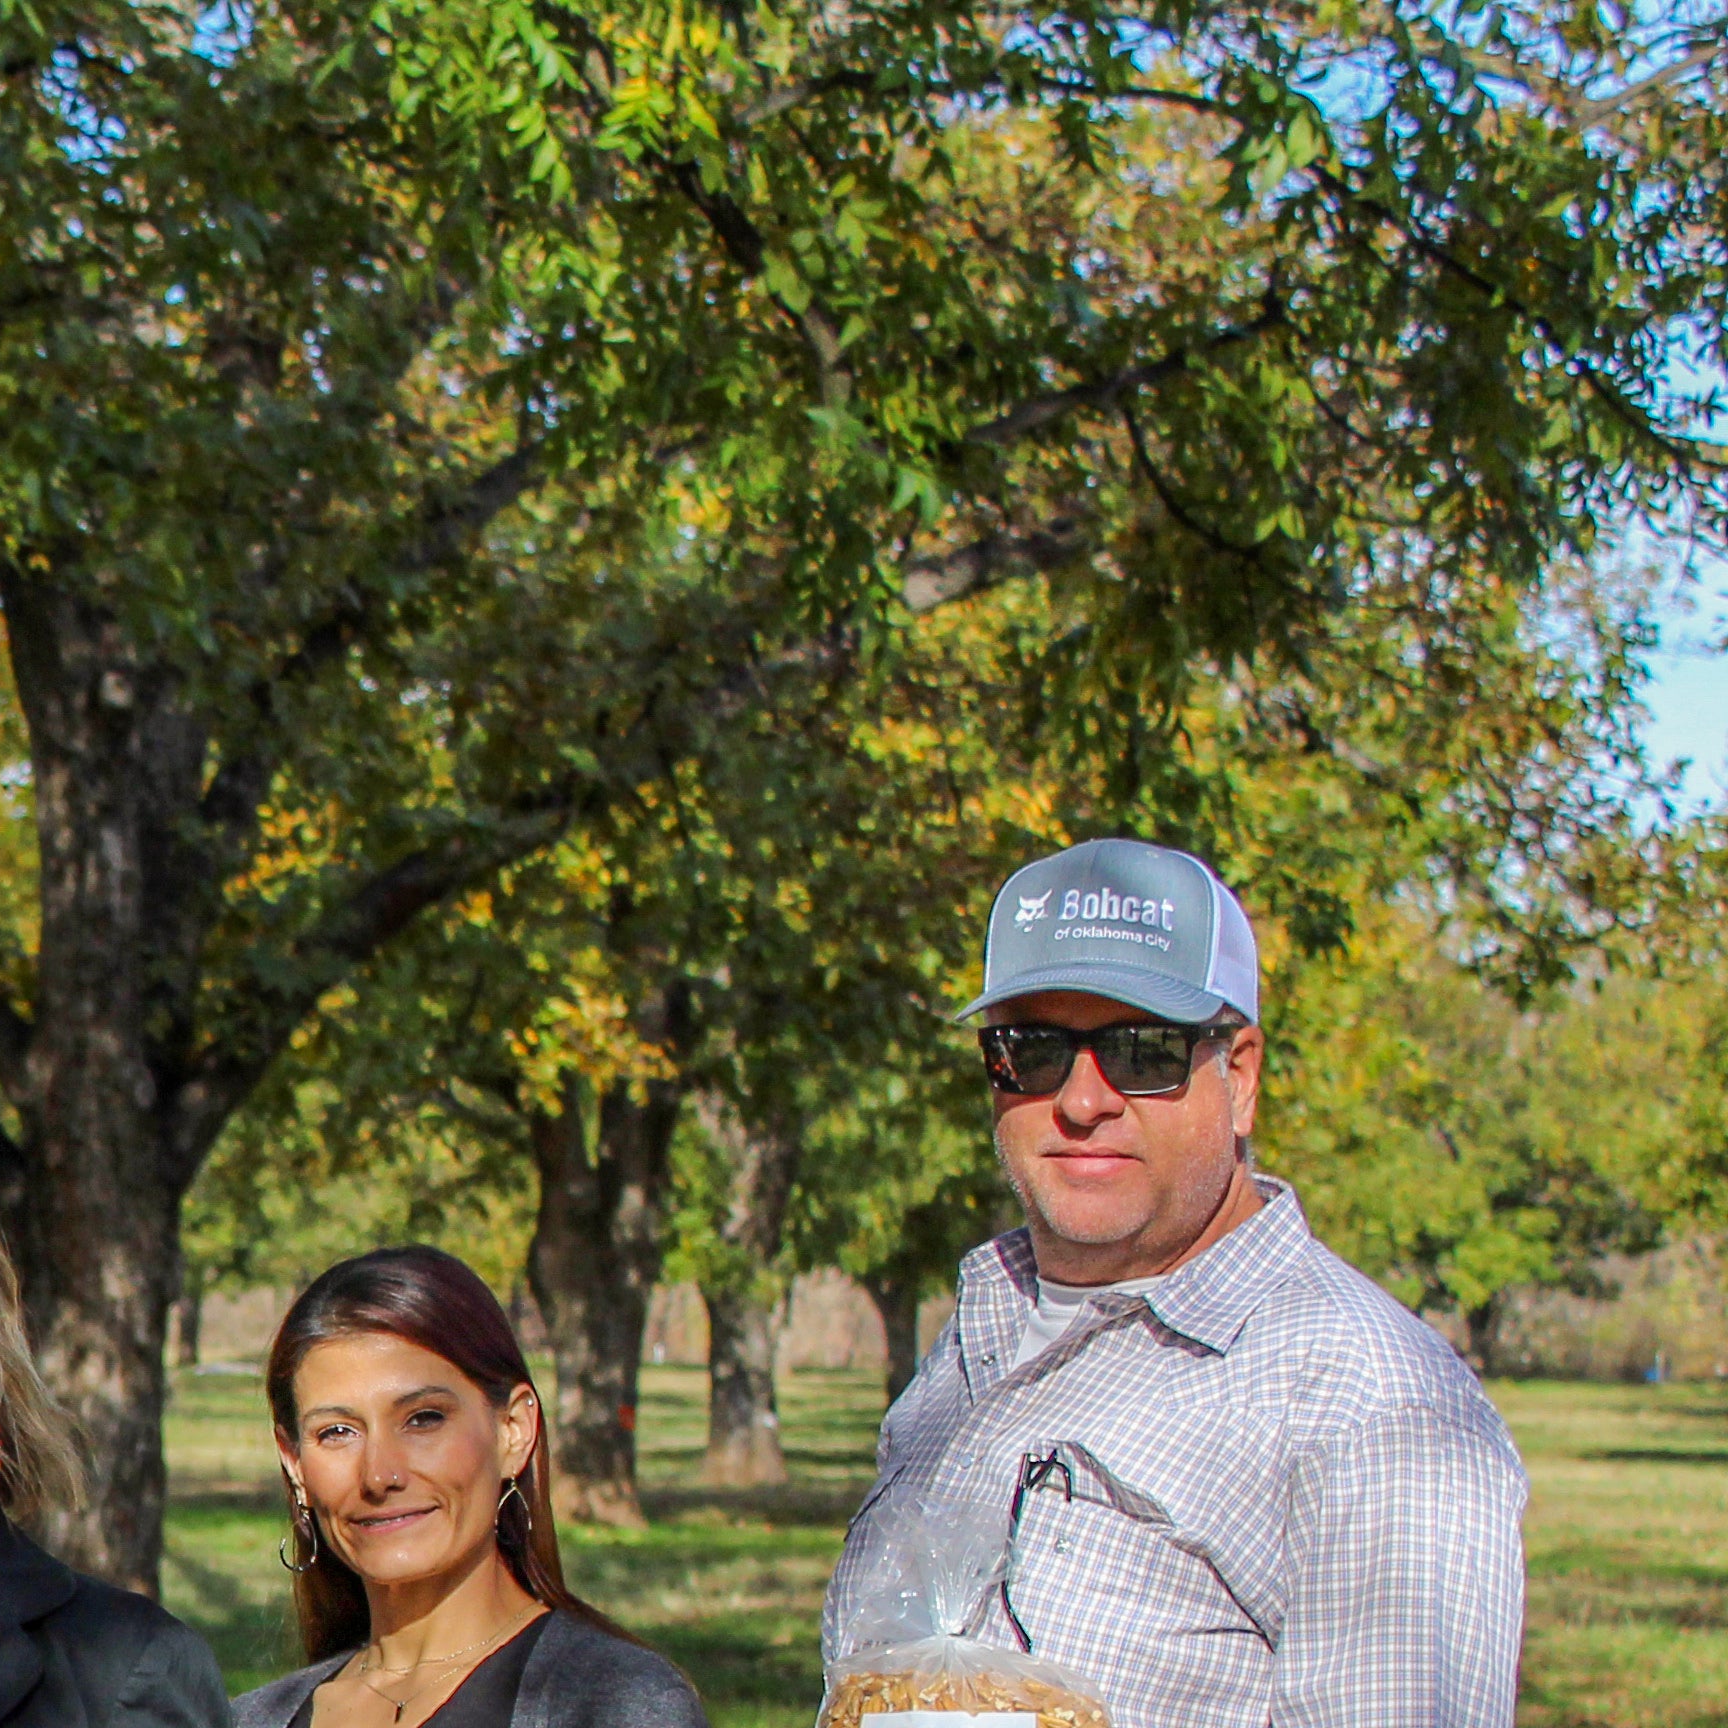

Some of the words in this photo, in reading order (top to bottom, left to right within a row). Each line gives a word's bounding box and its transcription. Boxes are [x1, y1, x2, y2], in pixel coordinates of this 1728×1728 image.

[1058, 886, 1175, 932] Bobcat
[1054, 926, 1071, 940] of
[1072, 926, 1143, 944] Oklahoma
[1145, 933, 1172, 952] City
